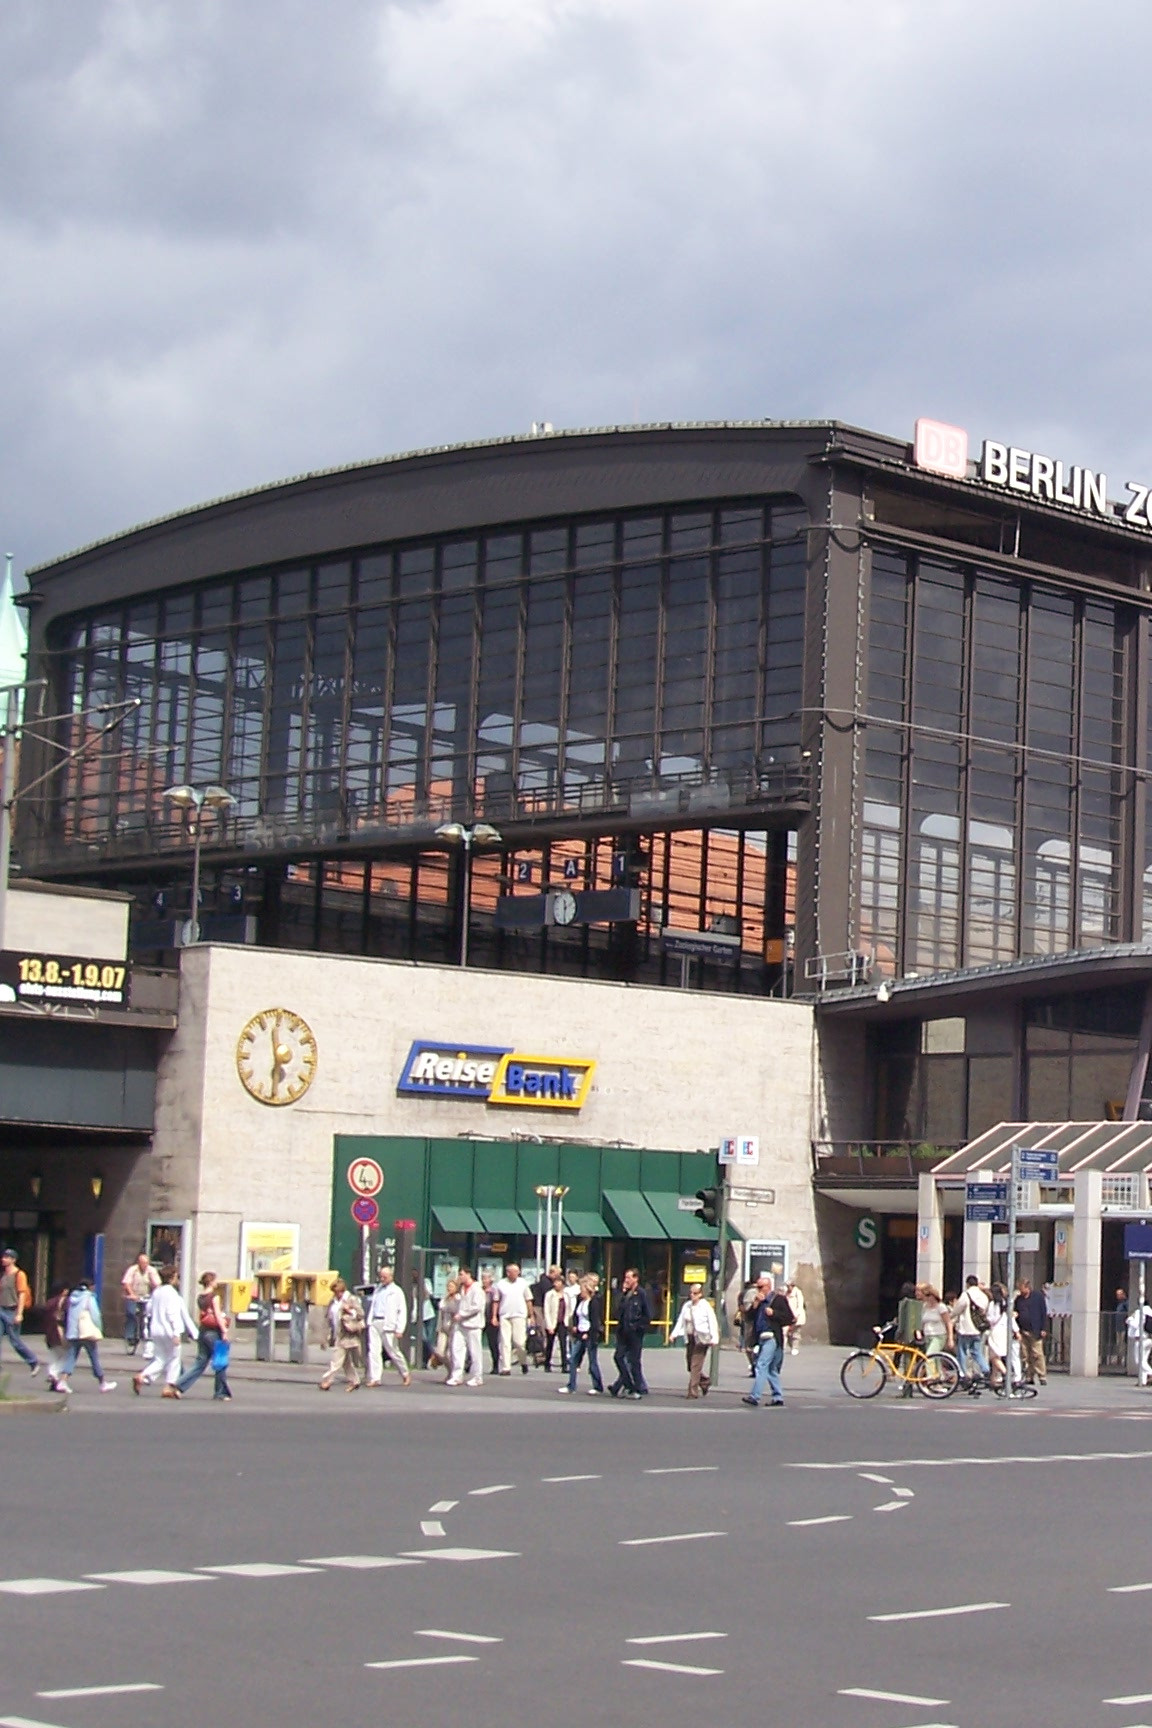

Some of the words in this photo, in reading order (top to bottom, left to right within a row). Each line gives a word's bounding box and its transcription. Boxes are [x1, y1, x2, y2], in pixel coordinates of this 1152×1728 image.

[924, 428, 961, 467] DB
[984, 439, 1107, 513] BERLIN
[518, 863, 528, 879] 2
[566, 861, 576, 876] A
[234, 884, 242, 901] 3
[414, 1052, 495, 1084] Reise
[506, 1064, 578, 1095] Bank
[858, 1217, 877, 1249] S
